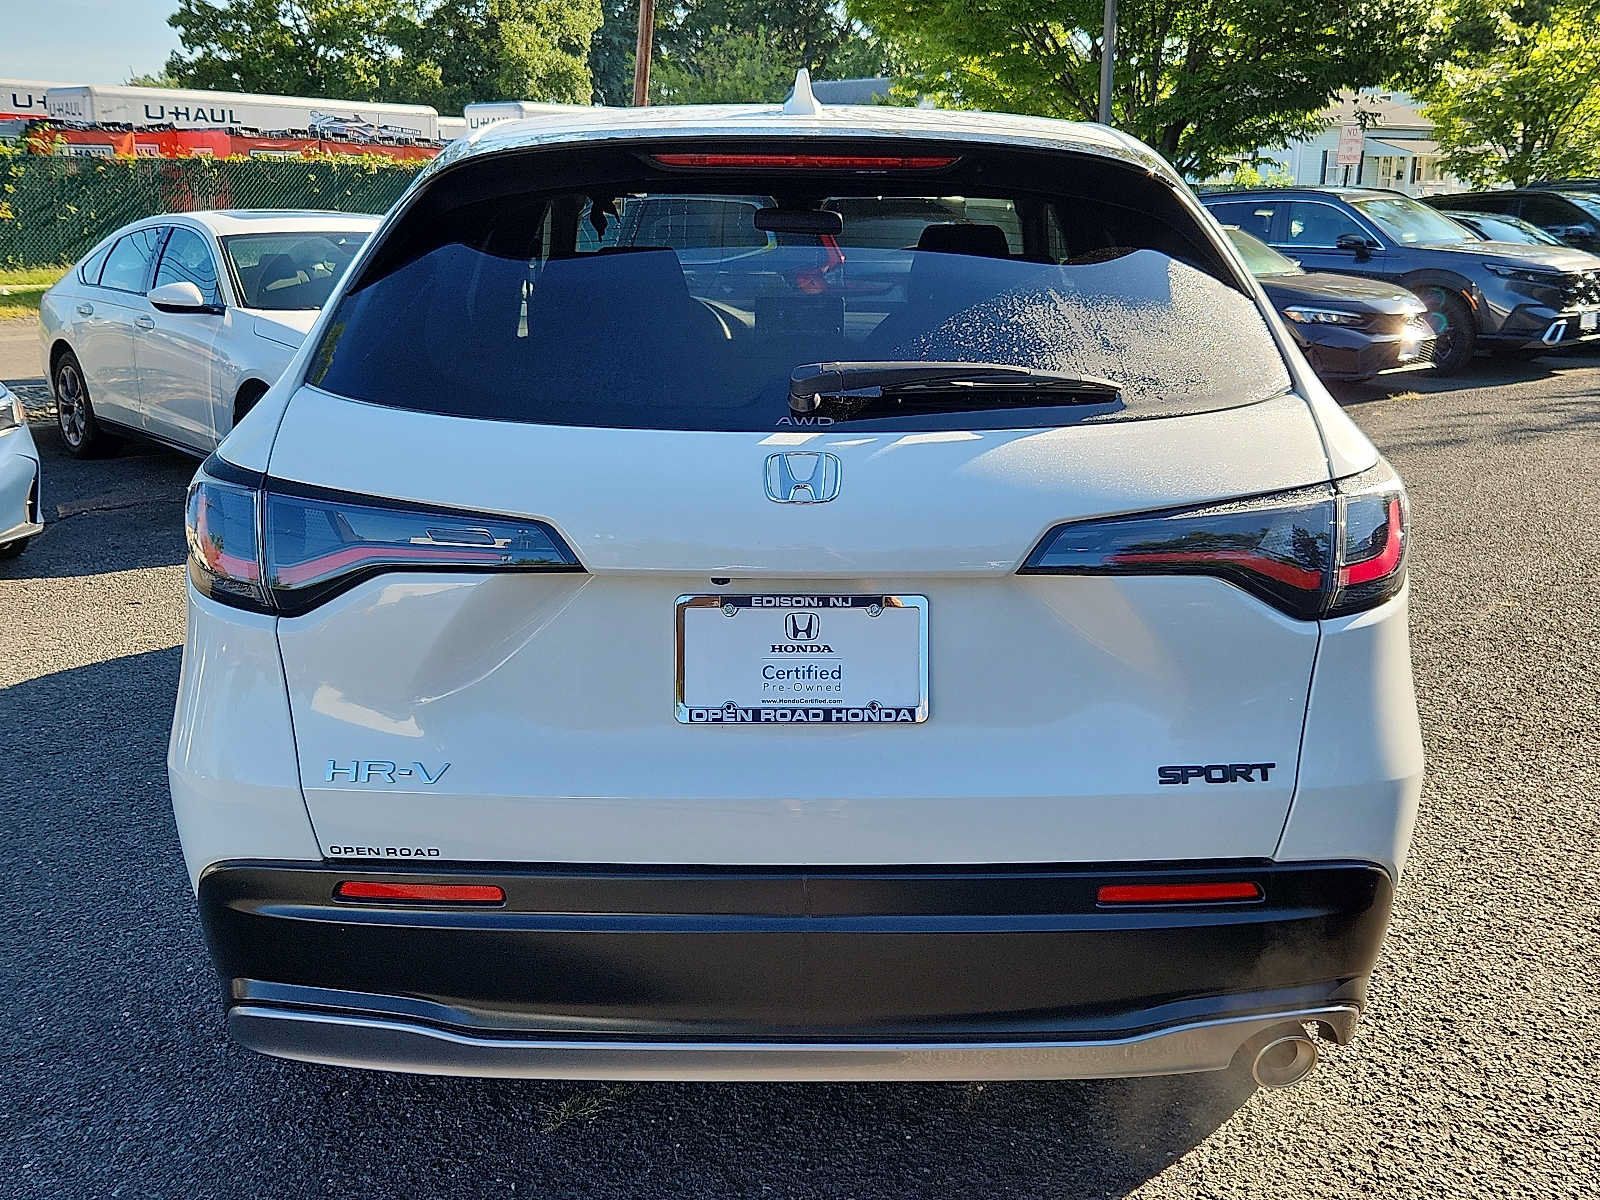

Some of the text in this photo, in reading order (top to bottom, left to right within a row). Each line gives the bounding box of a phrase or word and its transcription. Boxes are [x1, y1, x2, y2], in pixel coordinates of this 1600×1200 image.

[144, 104, 242, 124] U-HAUL
[775, 416, 835, 426] AWD
[751, 596, 852, 607] EDISON, NJ
[770, 644, 834, 653] HONDA
[762, 664, 842, 680] Certified
[763, 682, 841, 692] Pre-Owned
[691, 709, 913, 722] OPEN ROAD HONDA
[324, 759, 451, 784] HR-V
[1158, 763, 1276, 784] SPORT
[329, 845, 440, 857] OPEN ROAD
